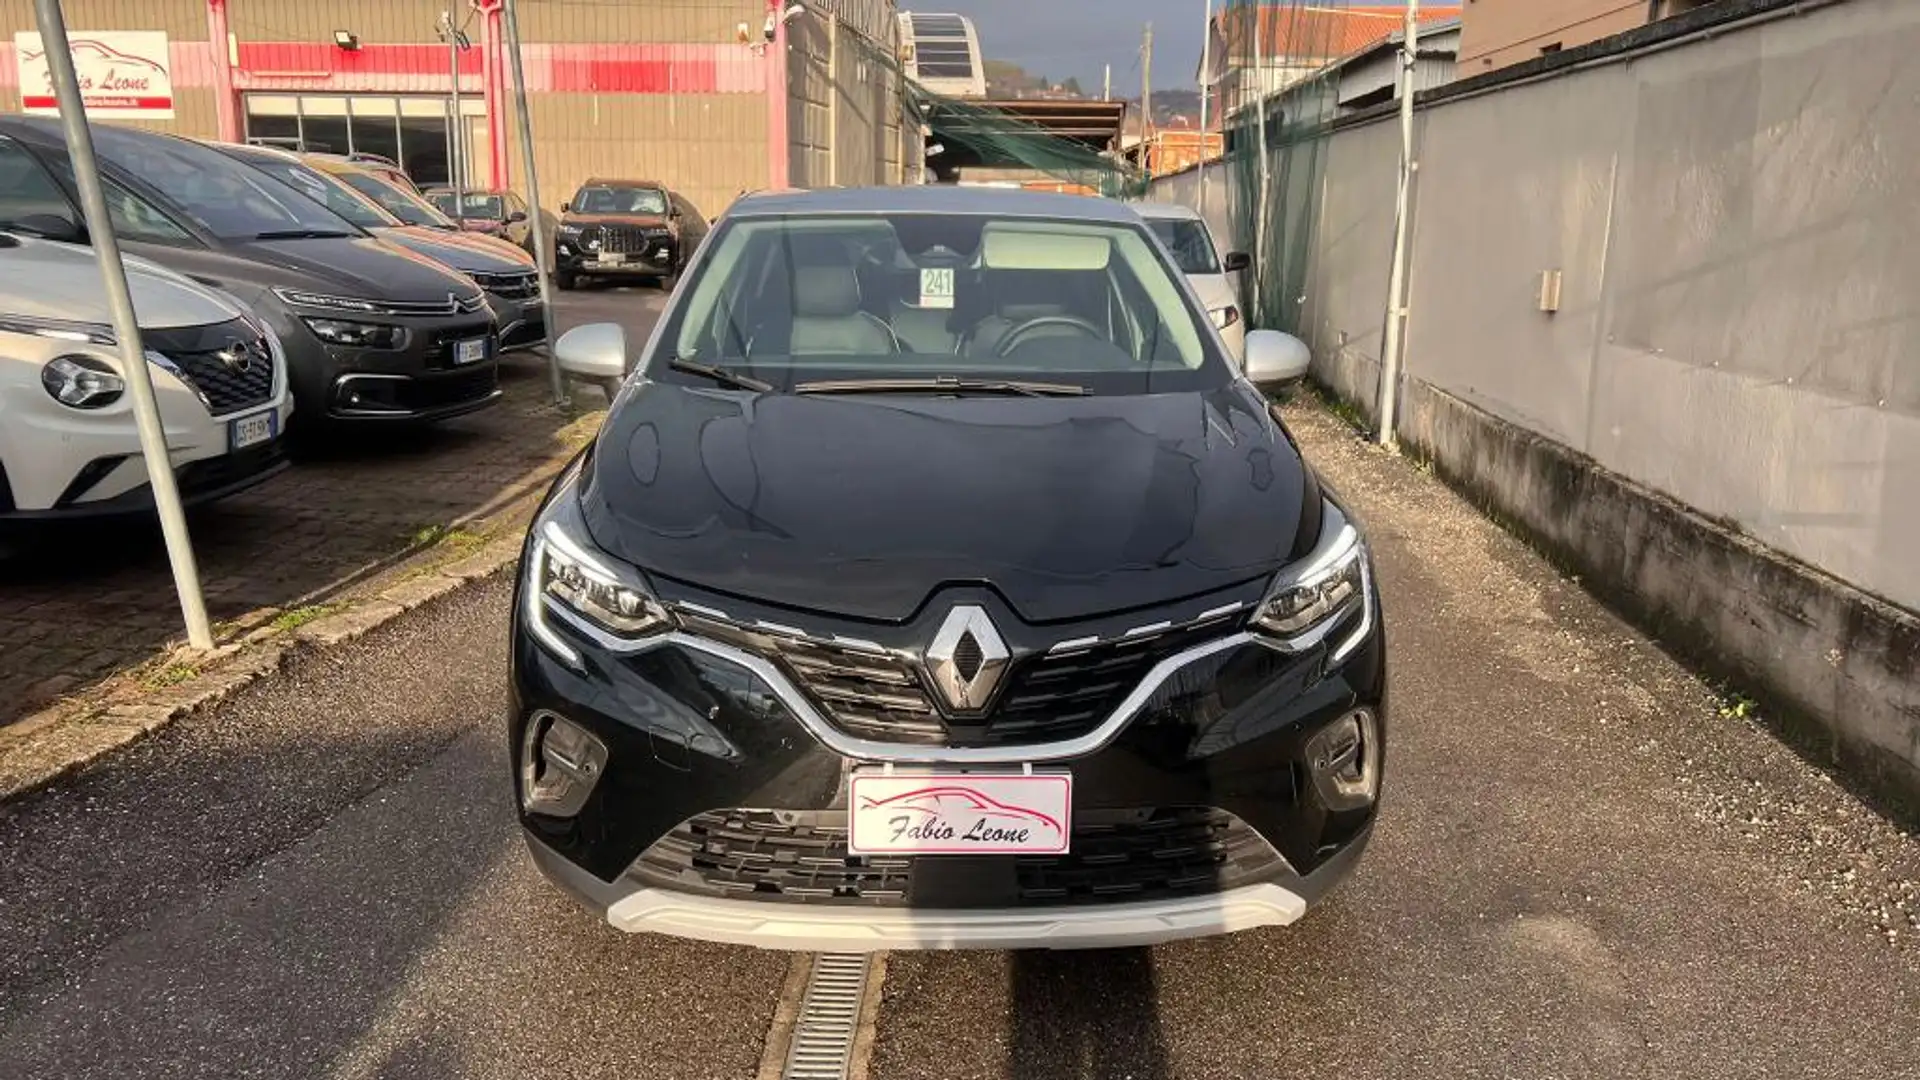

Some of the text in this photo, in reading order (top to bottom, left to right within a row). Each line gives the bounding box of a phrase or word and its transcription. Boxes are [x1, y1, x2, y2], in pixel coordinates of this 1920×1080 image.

[99, 68, 149, 91] Leone
[924, 269, 951, 294] 241
[888, 815, 1030, 843] Fabio Leone
